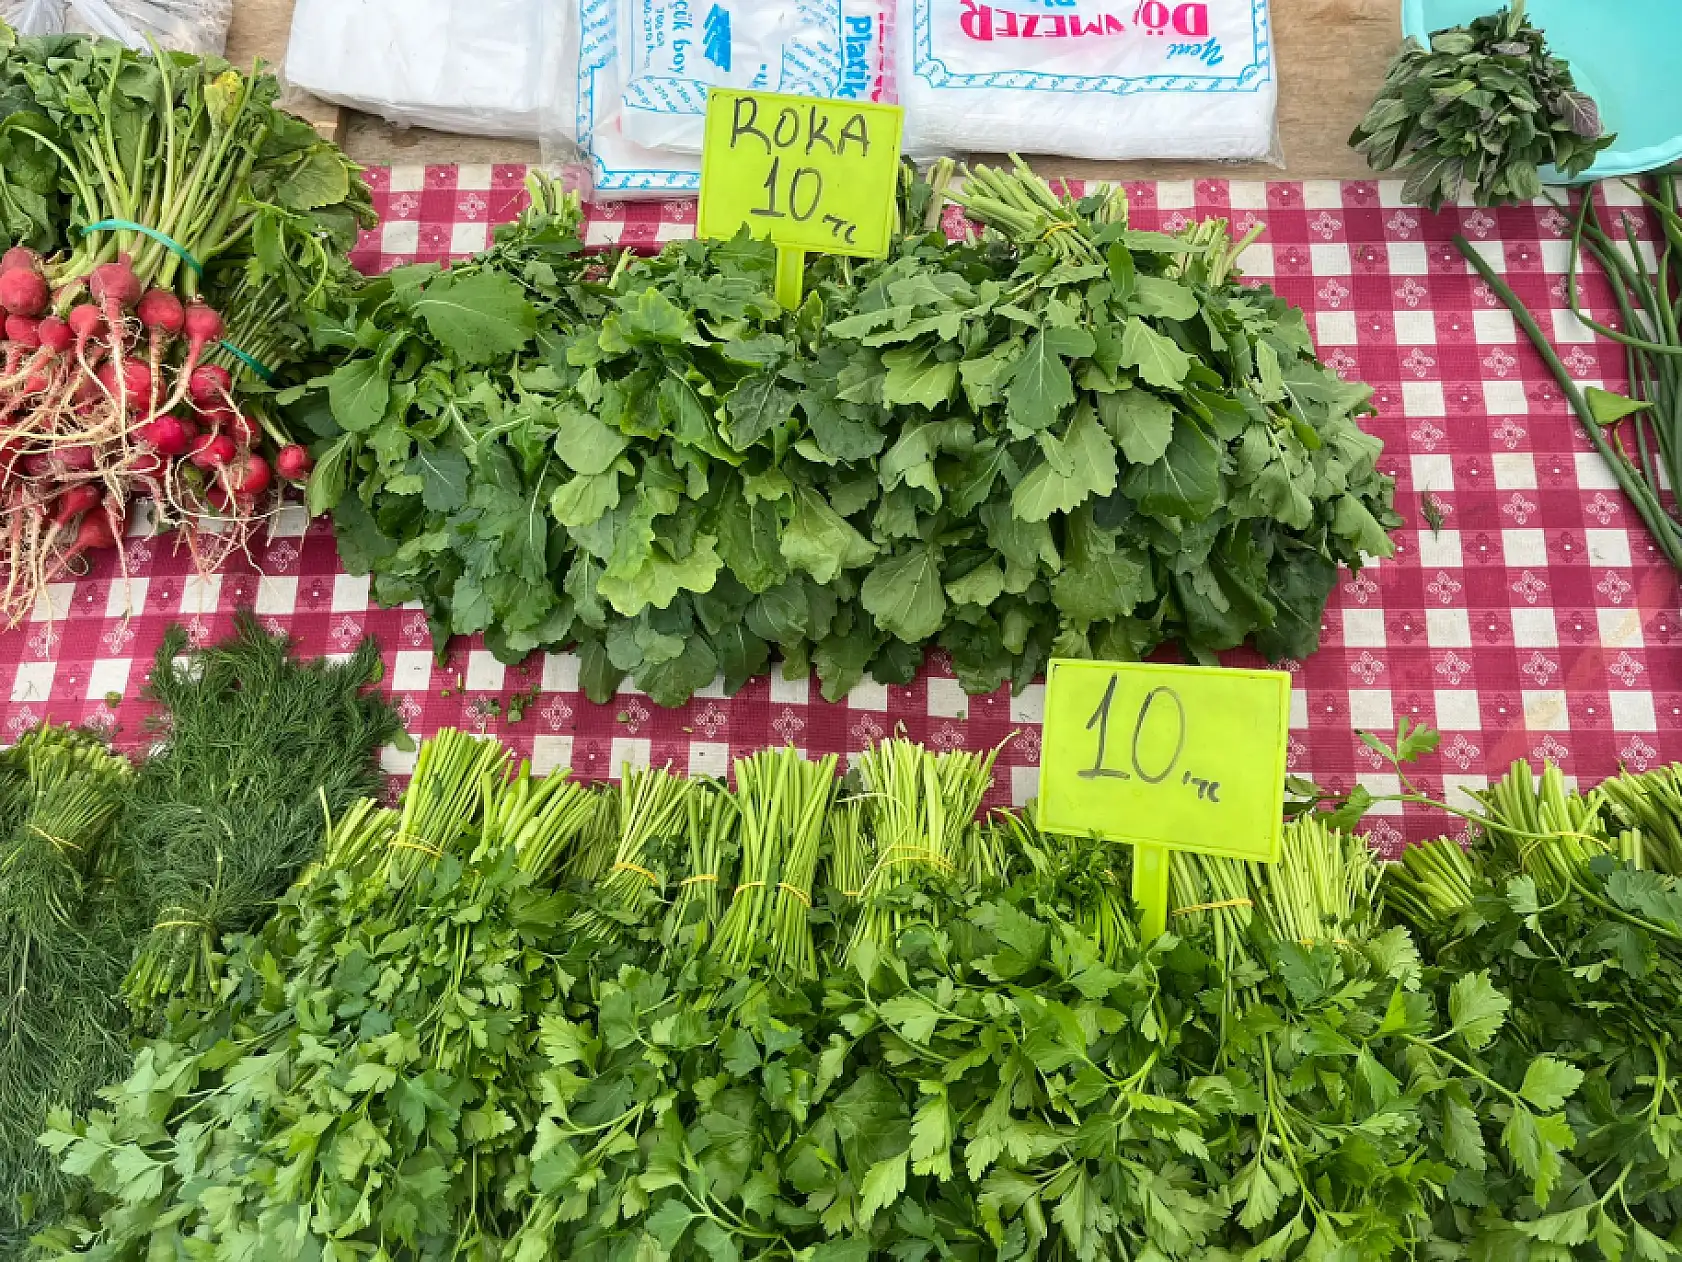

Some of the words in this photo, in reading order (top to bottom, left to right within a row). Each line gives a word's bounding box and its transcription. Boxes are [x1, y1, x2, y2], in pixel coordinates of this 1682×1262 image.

[668, 0, 693, 32] çük
[667, 39, 693, 75] boy
[1166, 36, 1225, 67] Yeni
[730, 96, 871, 157] ROKA
[750, 155, 824, 222] 10
